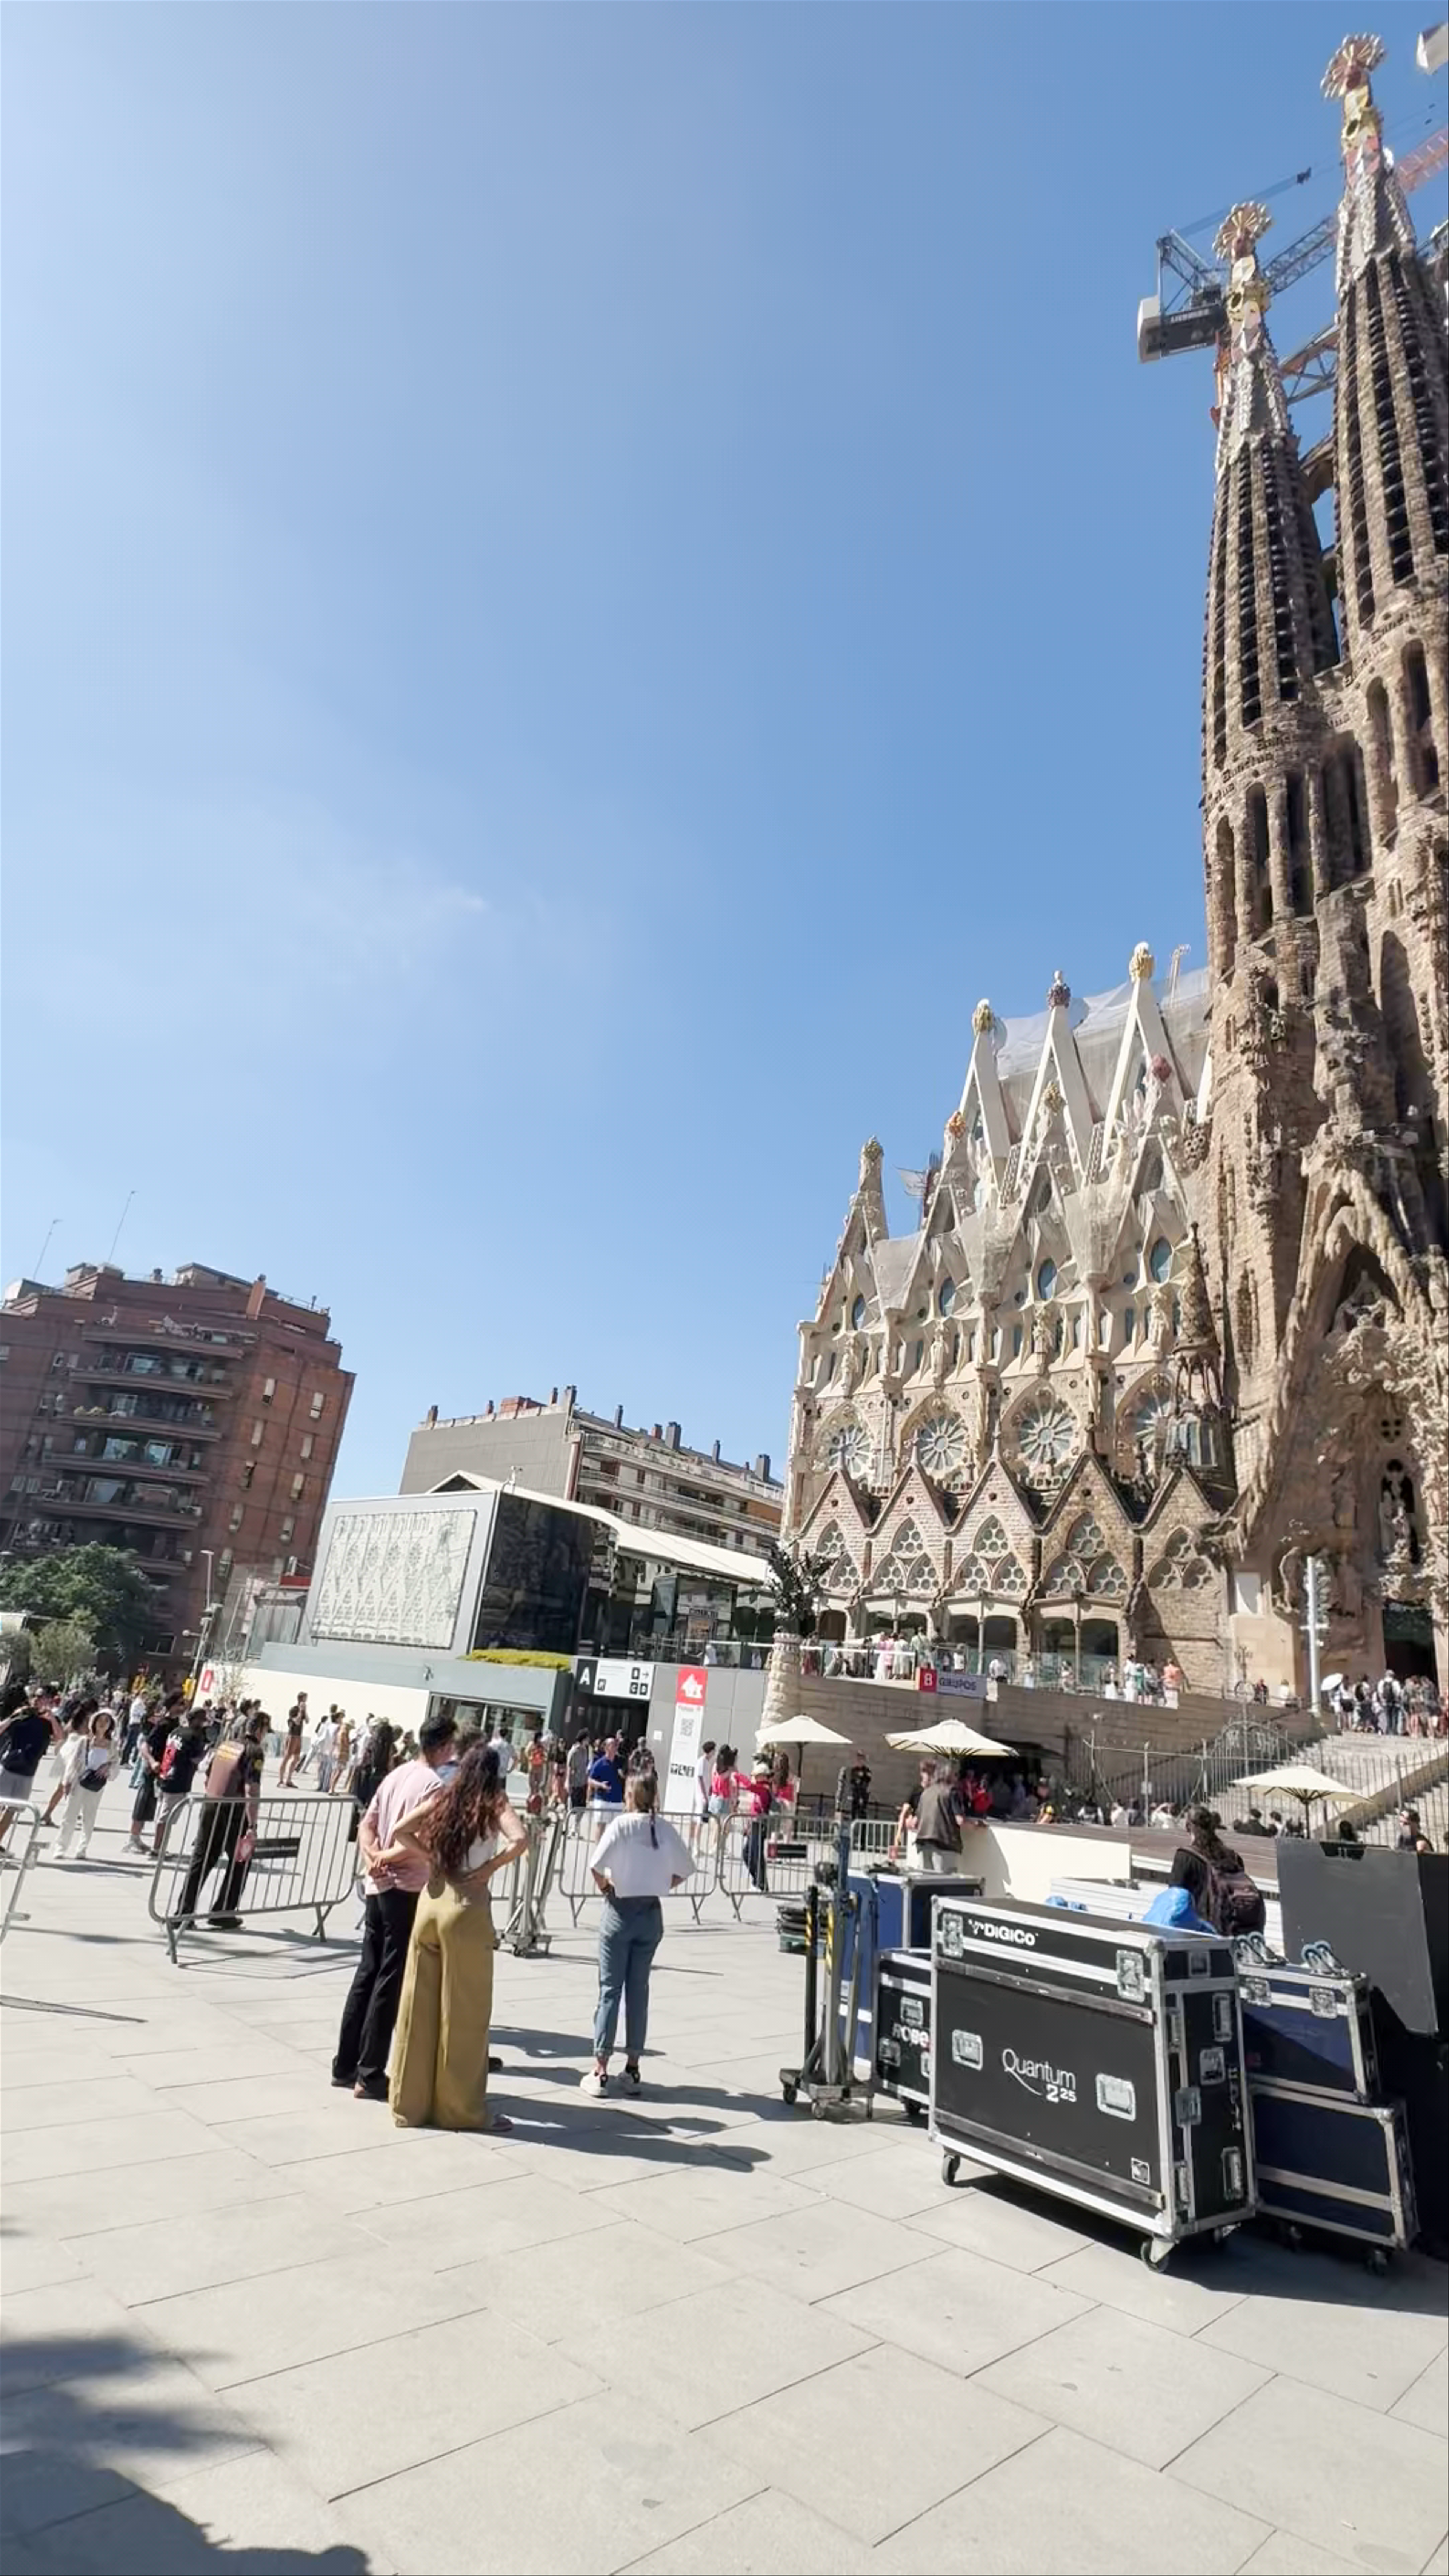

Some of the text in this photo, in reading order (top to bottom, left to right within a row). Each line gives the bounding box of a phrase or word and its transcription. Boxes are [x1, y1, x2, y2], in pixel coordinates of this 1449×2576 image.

[579, 1667, 590, 1685] A
[924, 1673, 933, 1686] B
[1002, 2048, 1076, 2092] Quantum
[1046, 2084, 1077, 2103] 225
